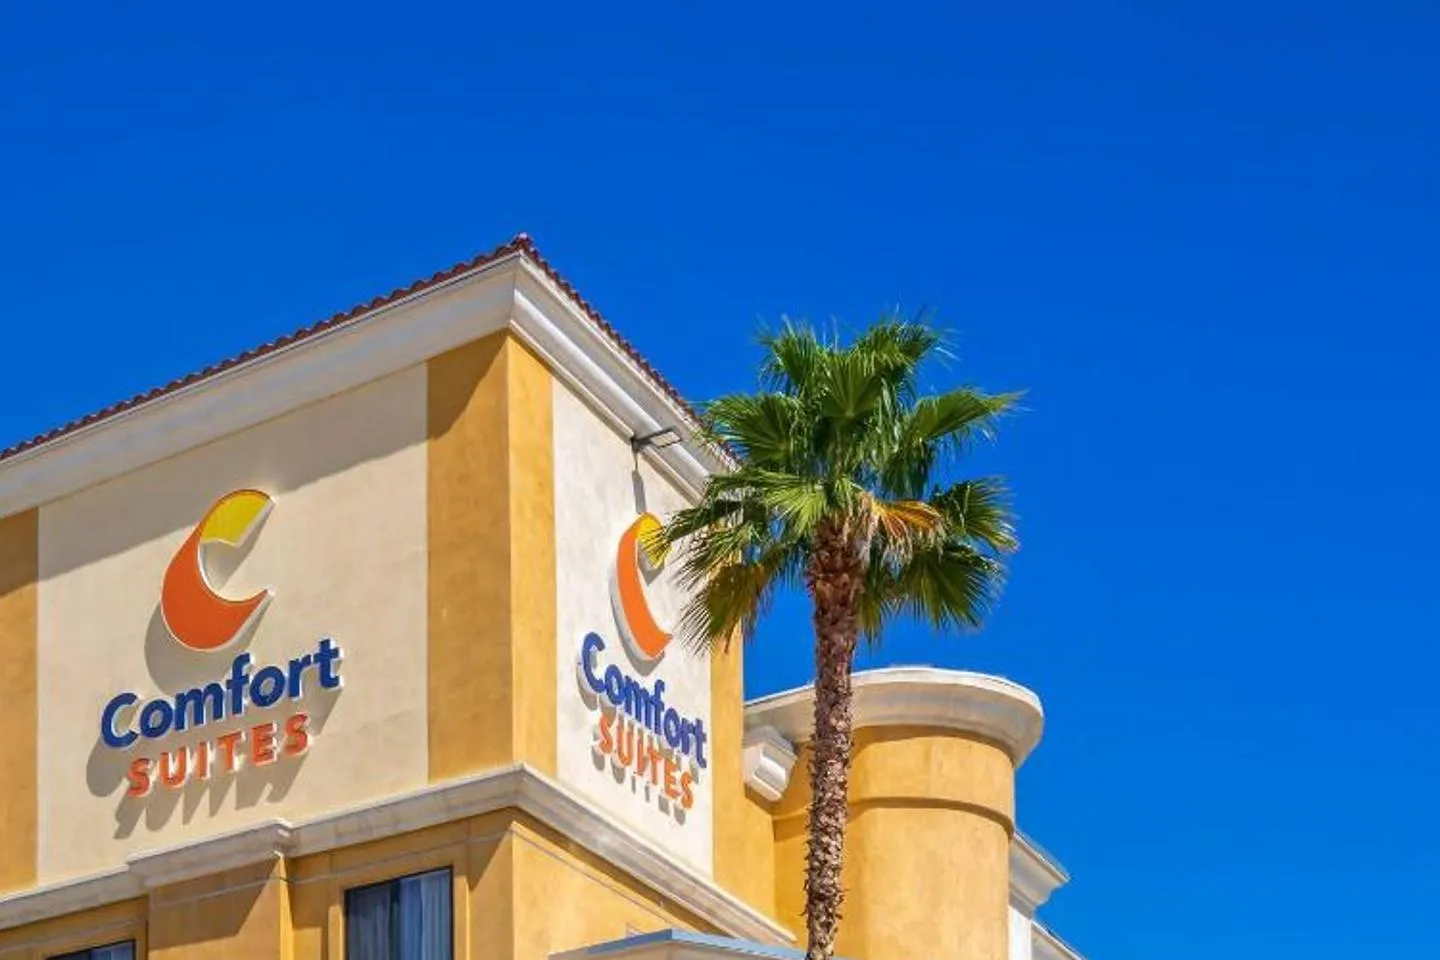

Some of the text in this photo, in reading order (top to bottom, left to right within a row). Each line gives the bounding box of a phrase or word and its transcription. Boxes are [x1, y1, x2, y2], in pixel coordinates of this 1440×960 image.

[101, 637, 341, 748] Comfort
[581, 631, 707, 769] Comfort
[127, 712, 310, 799] SUITES
[599, 712, 694, 809] SUITES
